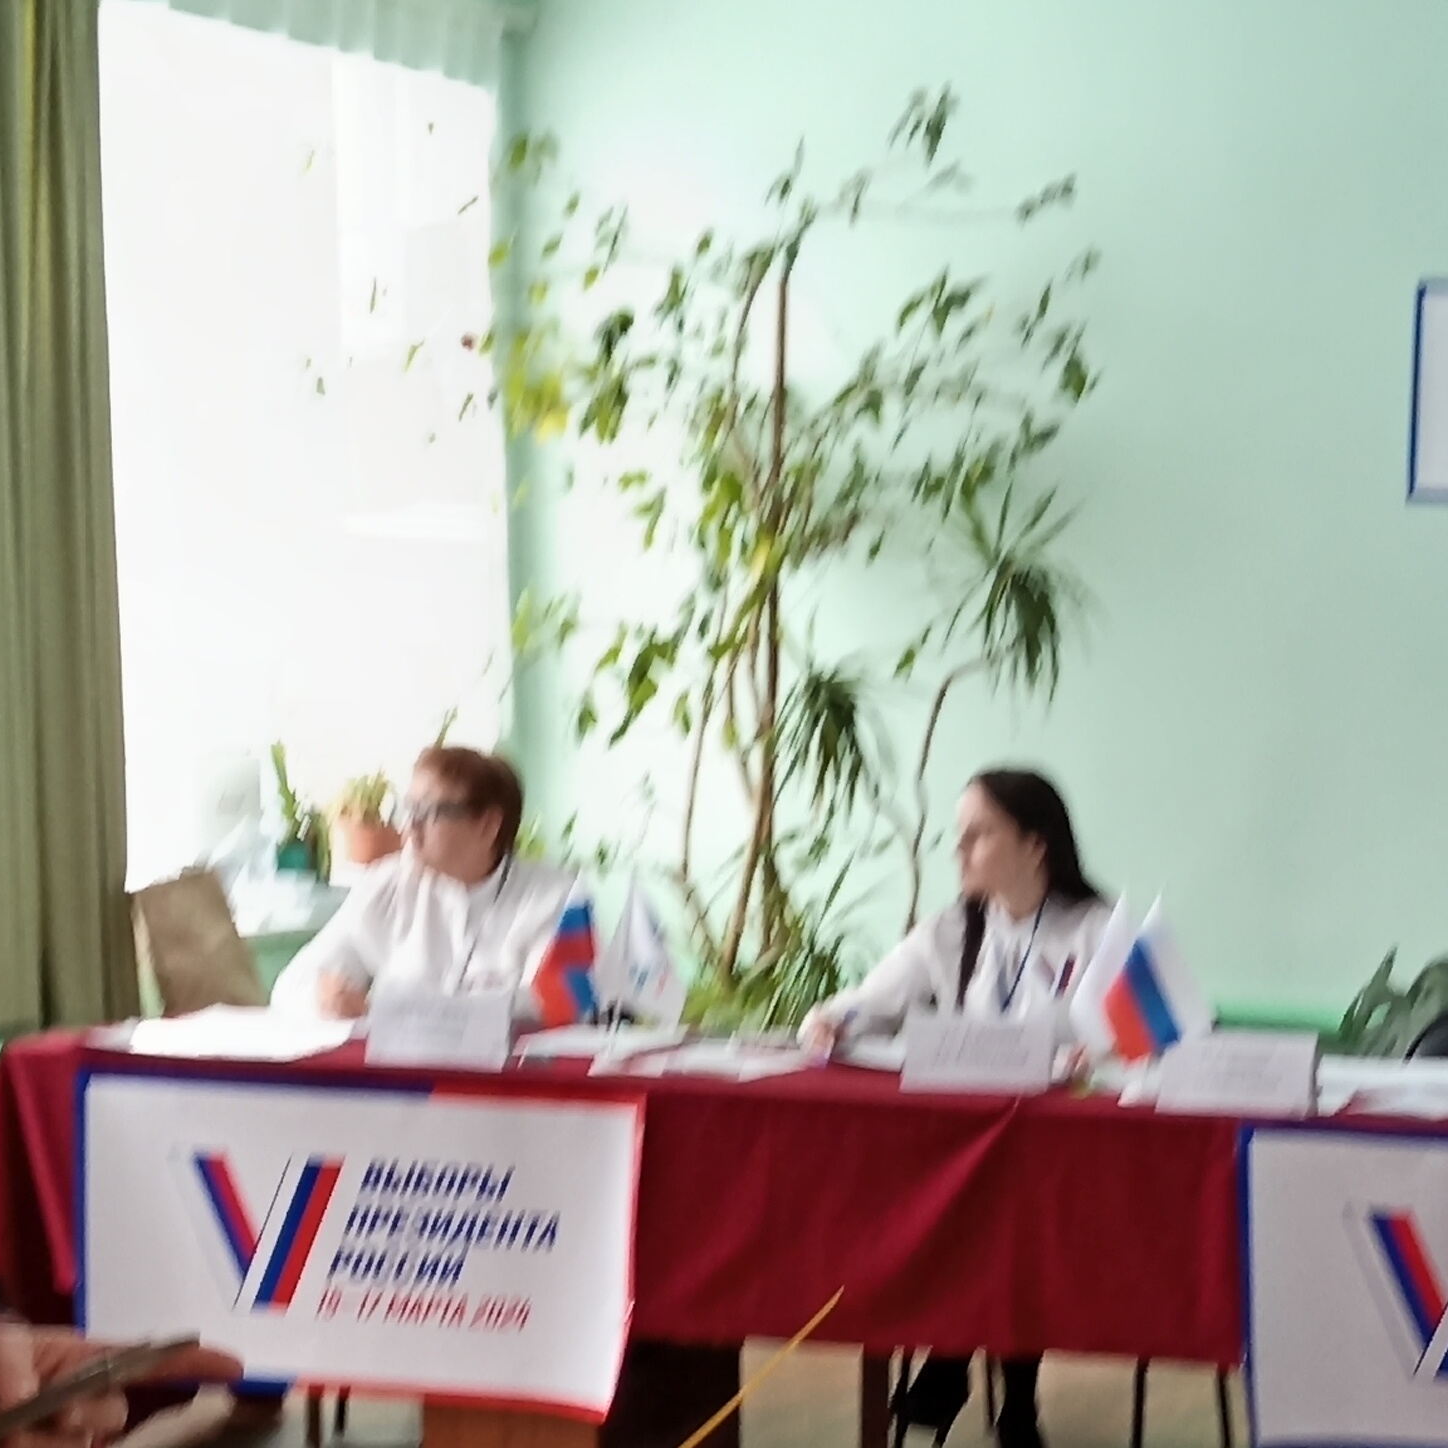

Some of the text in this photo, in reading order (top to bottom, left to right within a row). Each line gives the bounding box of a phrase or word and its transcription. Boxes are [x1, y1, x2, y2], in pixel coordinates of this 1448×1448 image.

[359, 1156, 515, 1204] ВЫБОРЫ
[344, 1203, 561, 1254] ПРЕЗИДЕНТА
[326, 1245, 466, 1292] РОССИИ
